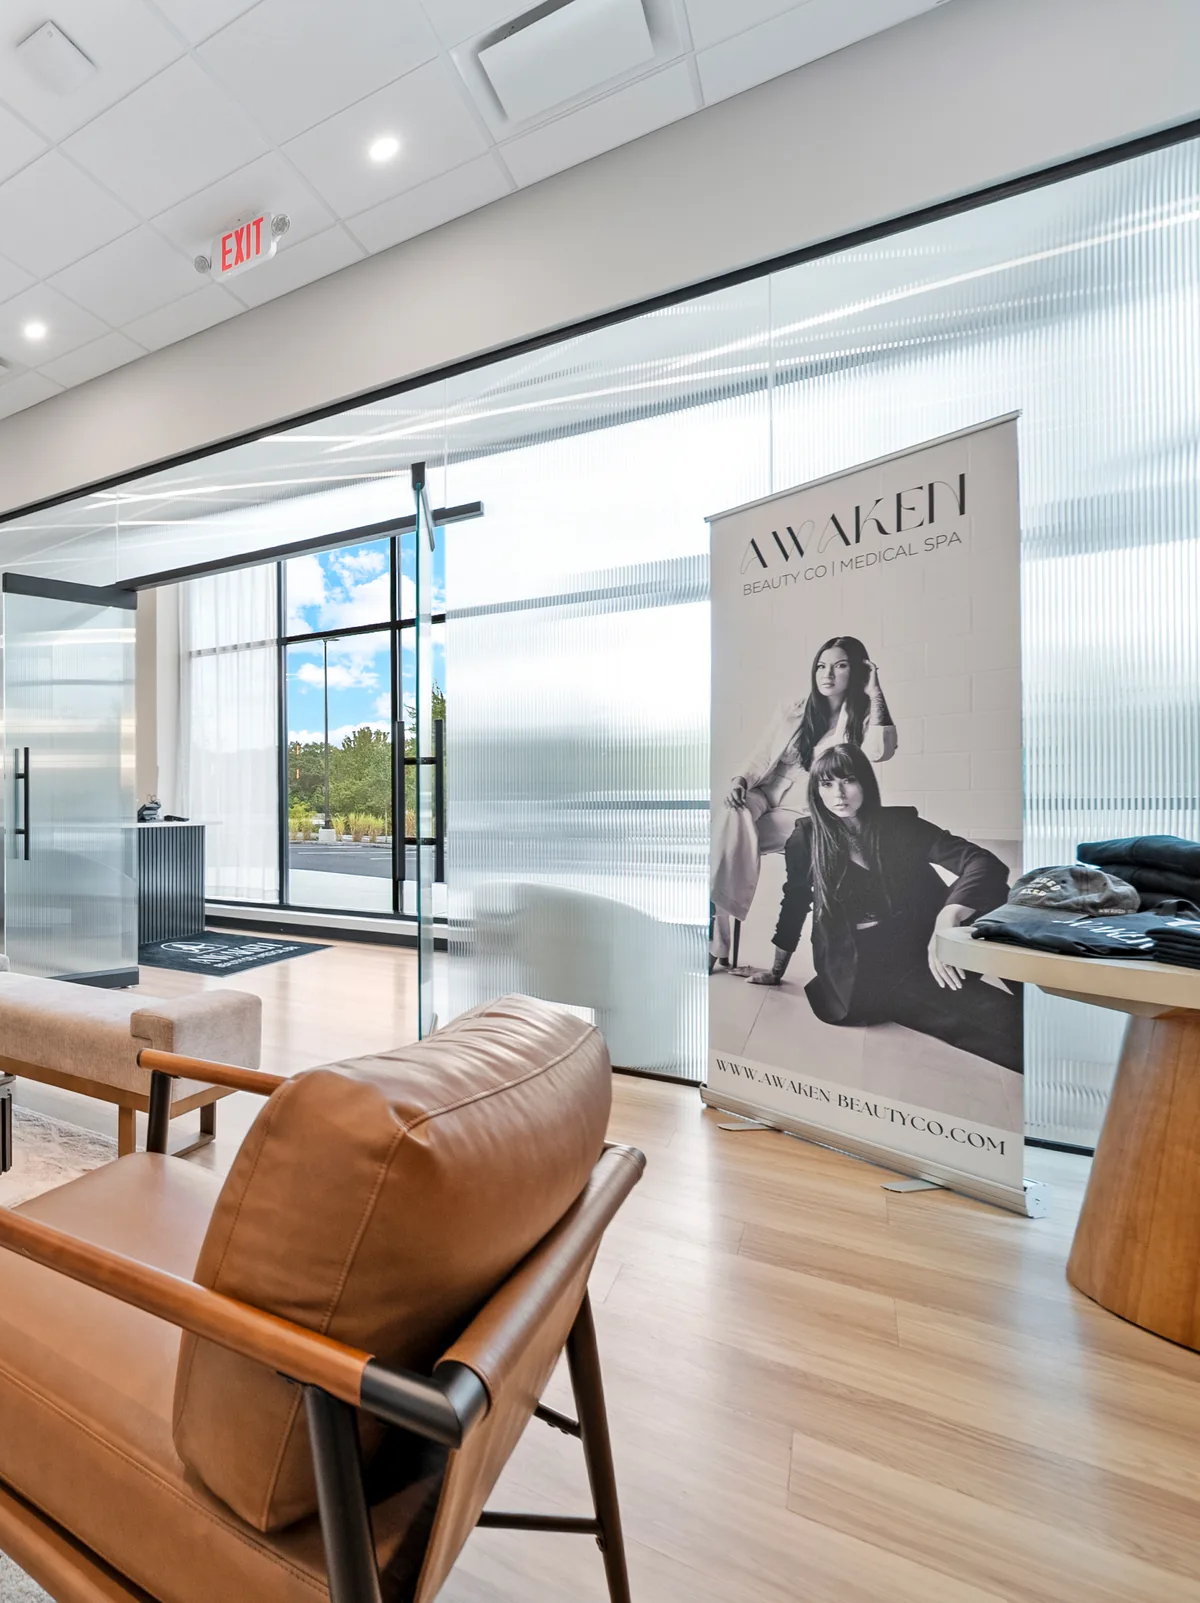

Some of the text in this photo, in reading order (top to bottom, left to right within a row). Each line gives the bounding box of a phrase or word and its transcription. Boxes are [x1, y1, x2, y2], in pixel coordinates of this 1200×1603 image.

[221, 216, 264, 272] EXIT
[740, 473, 966, 575] AWAKEN
[743, 571, 800, 596] BEAUTY
[804, 565, 827, 580] CO
[840, 543, 919, 573] MEDICAL
[924, 532, 962, 552] SPA
